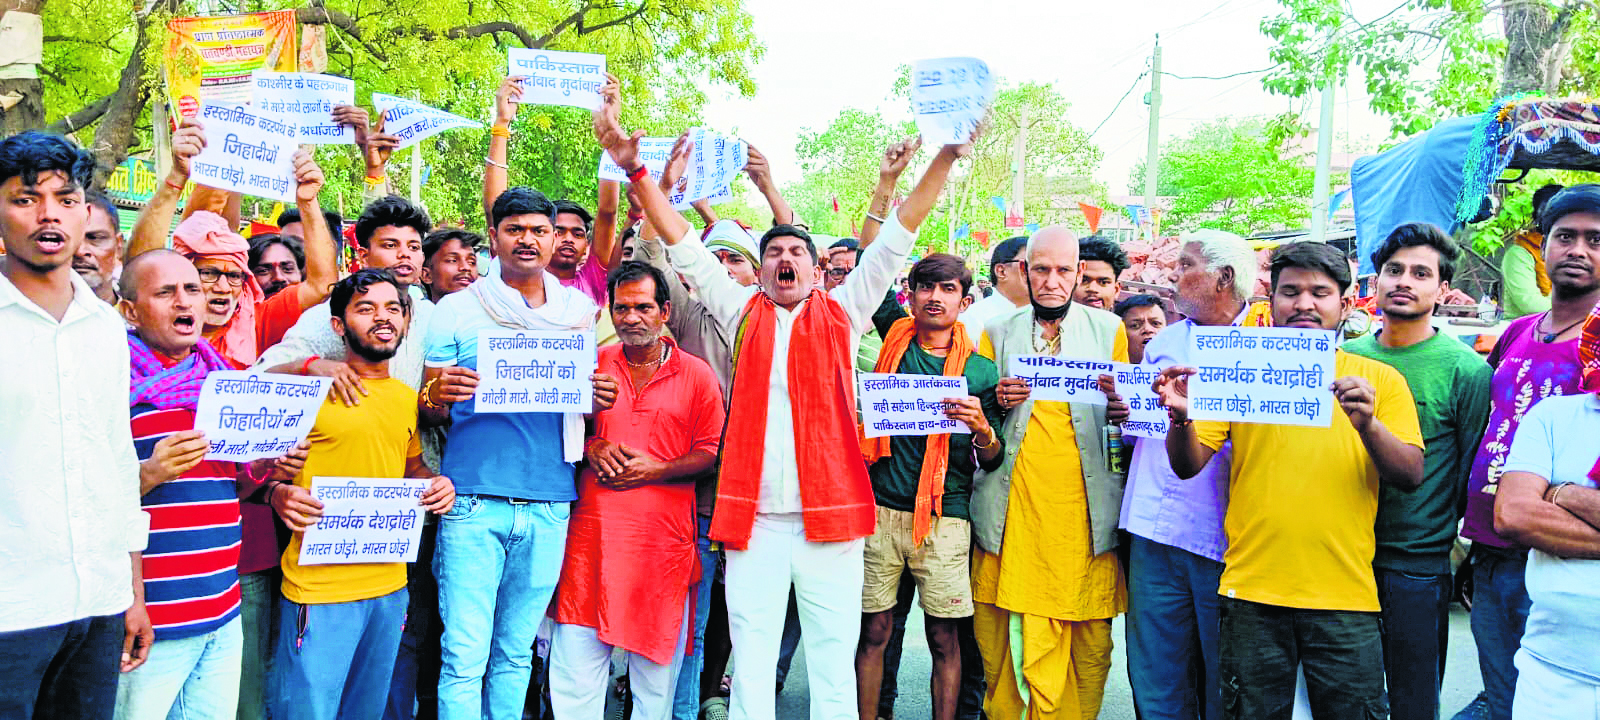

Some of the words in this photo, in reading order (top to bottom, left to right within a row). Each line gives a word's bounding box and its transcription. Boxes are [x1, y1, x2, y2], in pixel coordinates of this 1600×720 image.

[516, 54, 600, 75] पाकिस्तान
[294, 75, 304, 89] के
[306, 79, 348, 93] पहलगाम
[204, 104, 257, 127] इस्लामिक
[287, 123, 297, 138] के
[223, 133, 280, 164] जिहादीयों
[194, 161, 220, 178] भारत
[249, 174, 271, 189] भारत
[488, 333, 539, 351] इस्लामिक
[541, 335, 584, 351] कटरपंथी
[1196, 330, 1258, 350] इस्लामिक
[1261, 332, 1312, 352] कटरपंथ
[1315, 334, 1330, 352] के
[495, 359, 556, 381] जिहादीयों
[557, 360, 576, 380] को
[1198, 360, 1257, 384] समर्थक
[1261, 363, 1324, 389] देशद्रोही
[215, 375, 274, 394] इस्लामिक
[275, 380, 321, 398] कटरपंथी
[863, 375, 911, 392] इस्लामिक
[913, 376, 961, 390] आतंकवाद
[482, 388, 506, 405] गोली
[534, 388, 559, 405] गोली
[561, 388, 582, 405] मारो
[890, 399, 915, 413] सहेगा
[1129, 392, 1142, 410] के
[218, 405, 287, 431] जिहादीयों
[283, 408, 304, 428] को
[1193, 397, 1223, 412] भारत
[1260, 400, 1290, 415] भारत
[1294, 397, 1320, 420] छोड़ो
[873, 418, 916, 431] पाकिस्तान
[317, 480, 371, 500] इस्लामिक
[373, 482, 412, 499] कटरपंथ
[317, 508, 366, 530] समर्थक
[369, 508, 417, 532] देशद्रोही
[306, 542, 332, 556] भारत
[362, 542, 388, 555] भारत
[389, 538, 410, 558] छोड़ो
